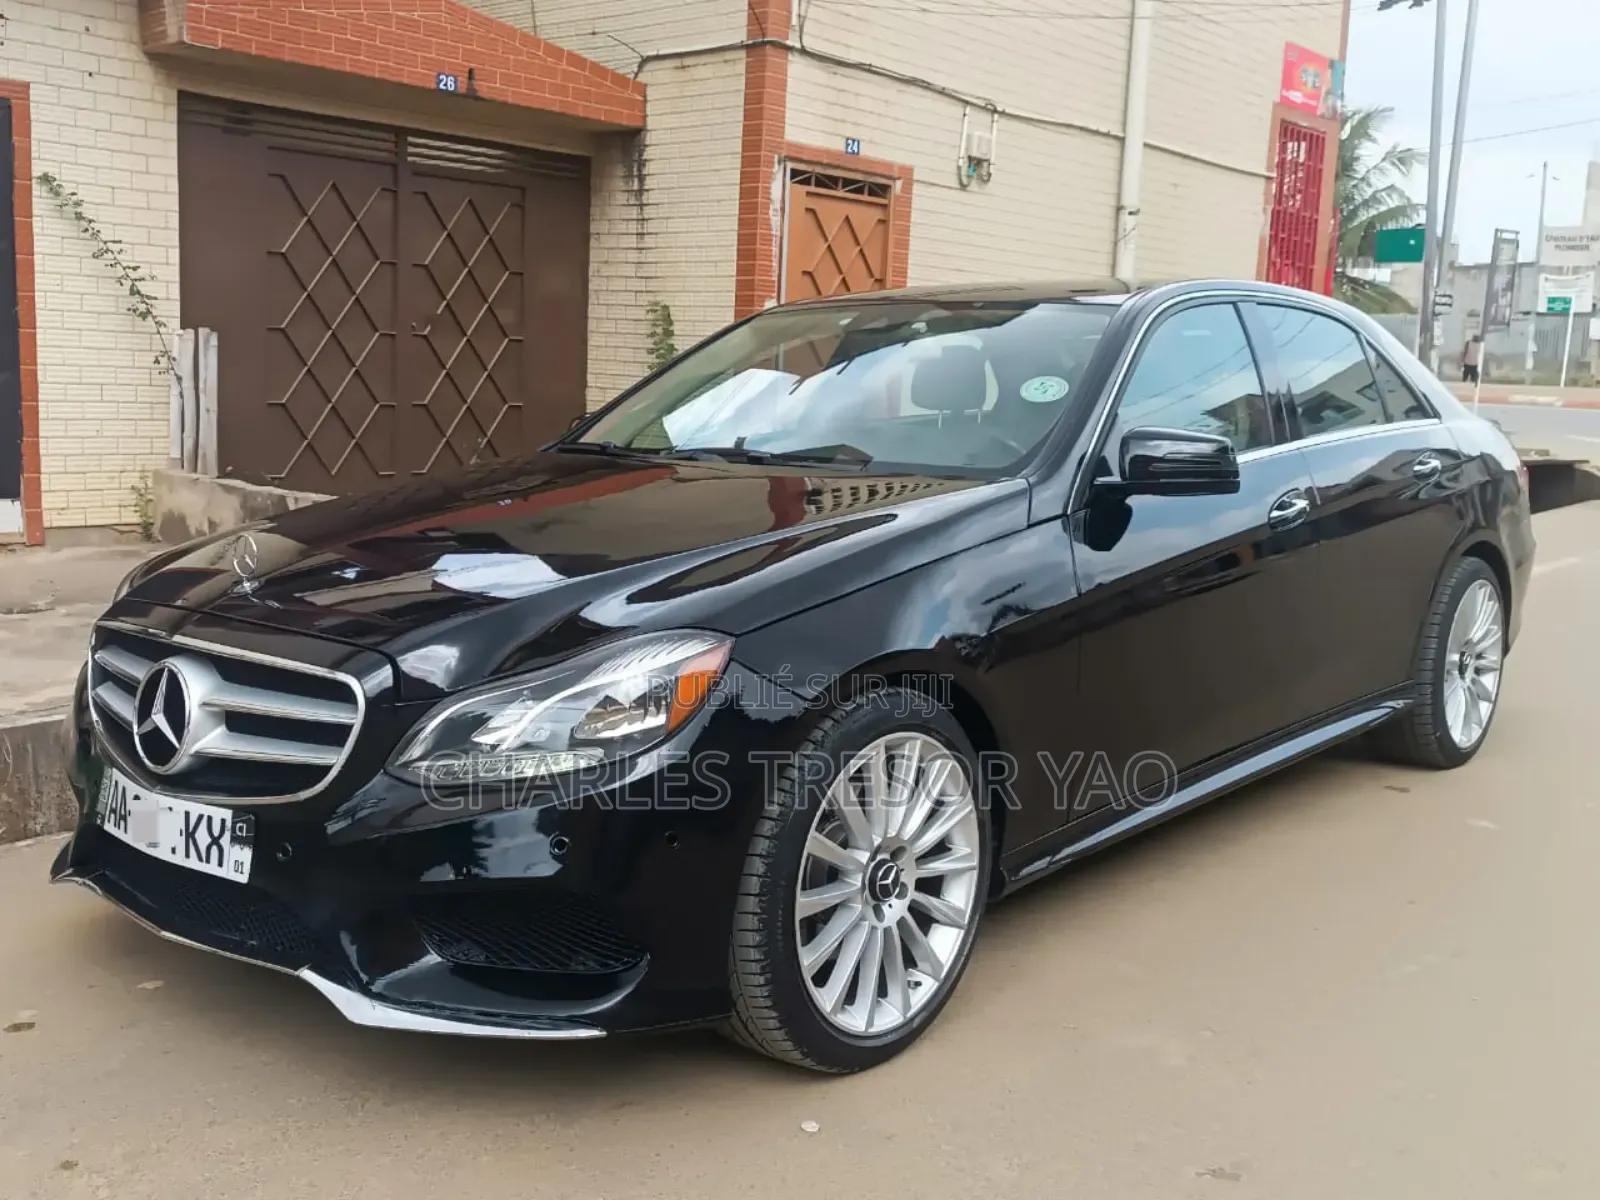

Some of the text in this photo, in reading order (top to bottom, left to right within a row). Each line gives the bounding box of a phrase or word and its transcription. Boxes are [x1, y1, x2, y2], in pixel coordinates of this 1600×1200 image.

[439, 74, 455, 91] 26
[847, 139, 859, 154] 24
[234, 859, 245, 875] 01
